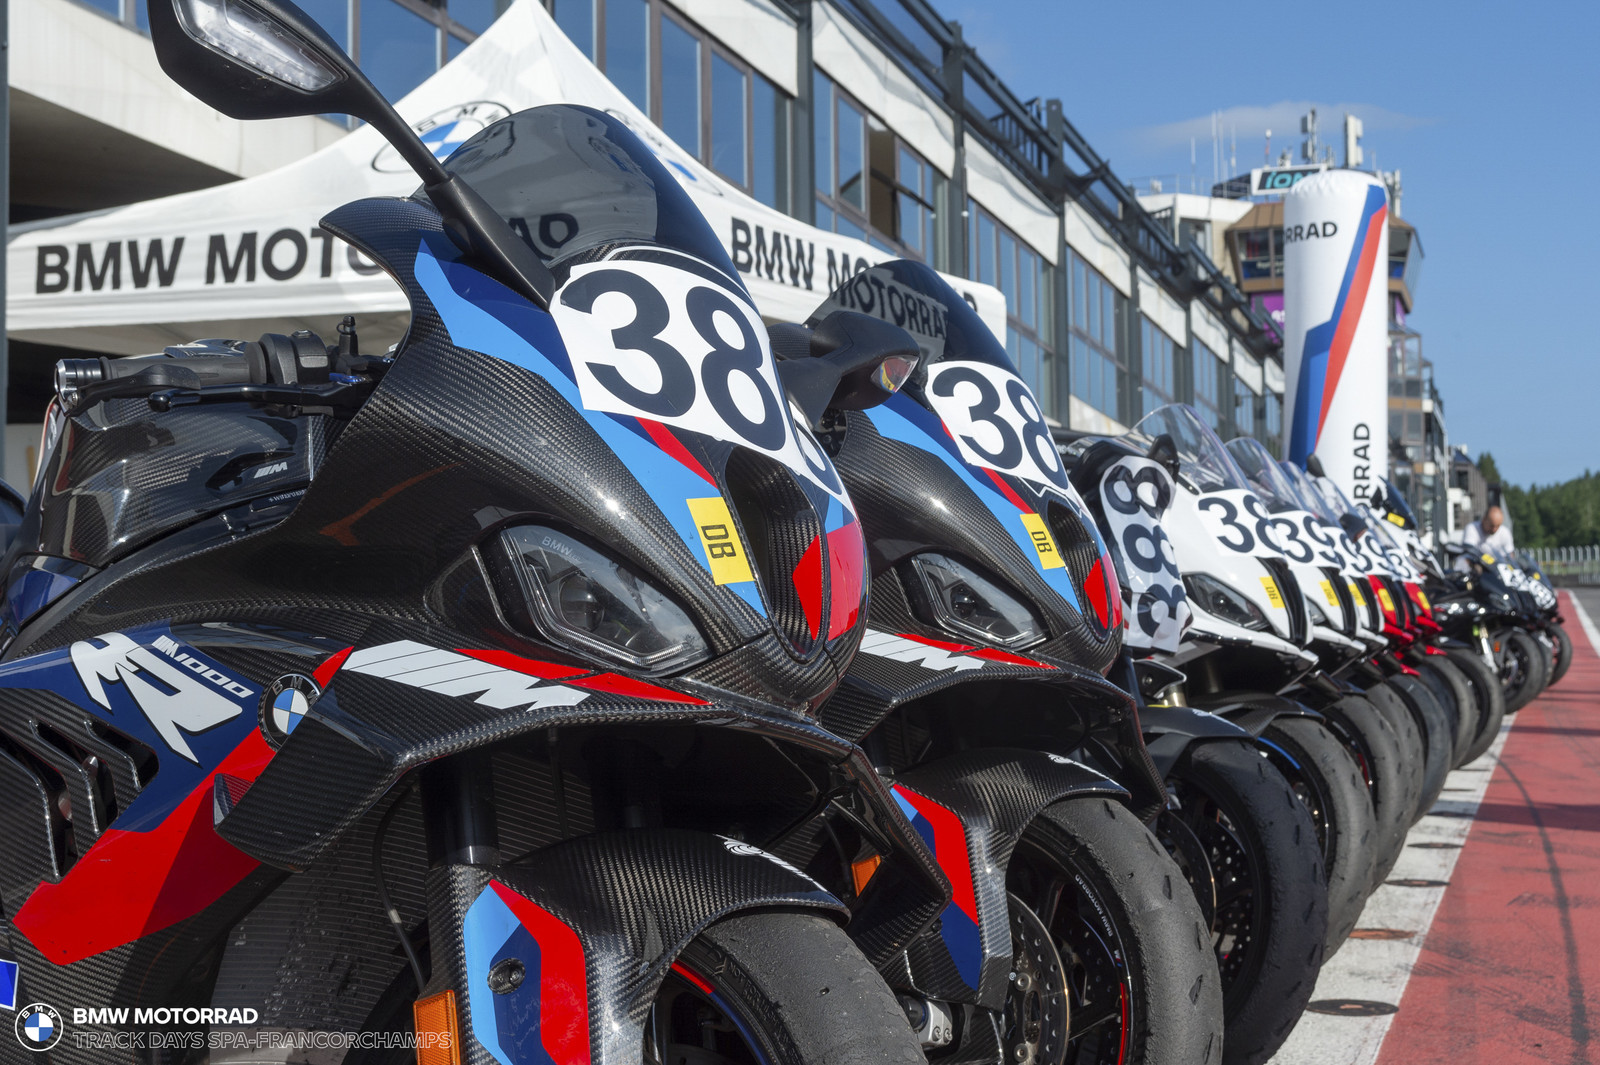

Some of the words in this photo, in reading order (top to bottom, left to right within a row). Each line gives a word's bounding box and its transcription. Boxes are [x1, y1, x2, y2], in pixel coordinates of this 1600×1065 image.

[731, 217, 815, 290] BMW
[1284, 221, 1338, 246] RRAD
[36, 237, 184, 293] BMW
[931, 366, 1069, 490] 38
[701, 524, 736, 559] DB
[1031, 531, 1053, 553] DB
[172, 652, 254, 699] 1000
